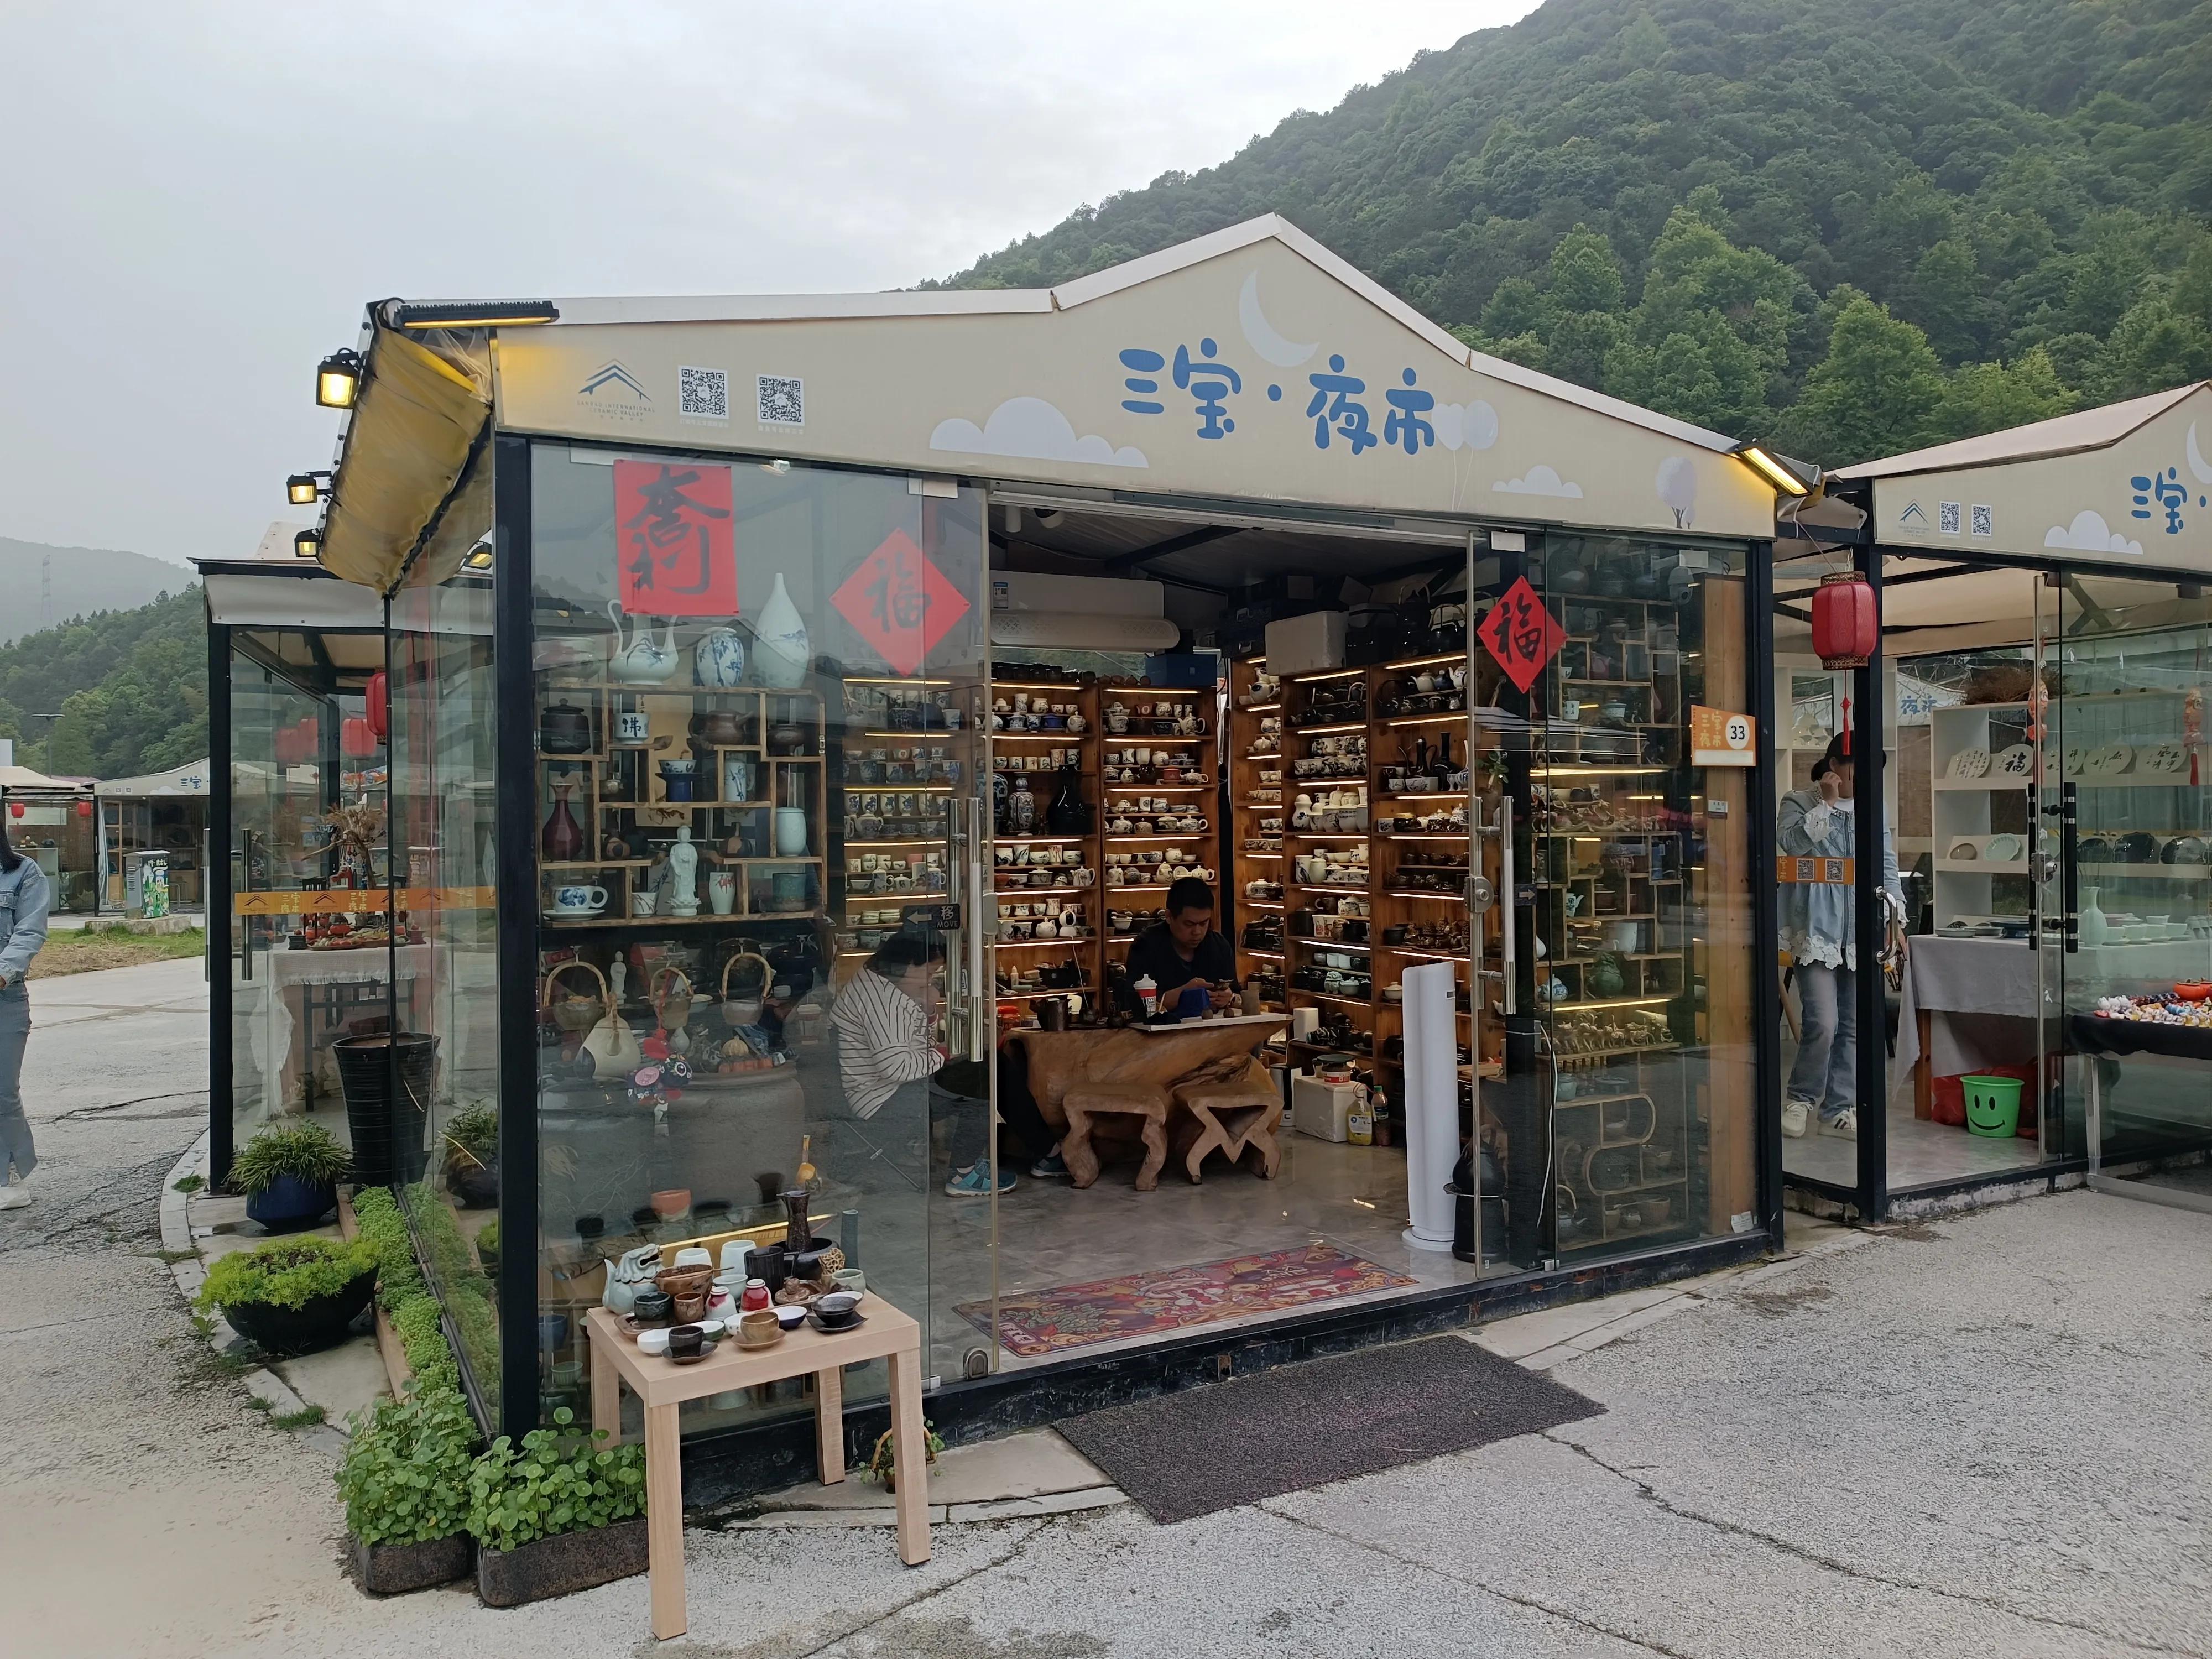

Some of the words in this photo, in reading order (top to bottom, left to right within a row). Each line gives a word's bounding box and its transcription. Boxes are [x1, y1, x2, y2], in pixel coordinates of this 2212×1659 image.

[605, 403, 655, 413] INTERNATIONAL
[1119, 337, 1435, 455] 三宝·夜市
[864, 551, 933, 634] 福
[1493, 593, 1542, 665] 福
[1730, 725, 1745, 740] 33
[941, 906, 953, 920] 移
